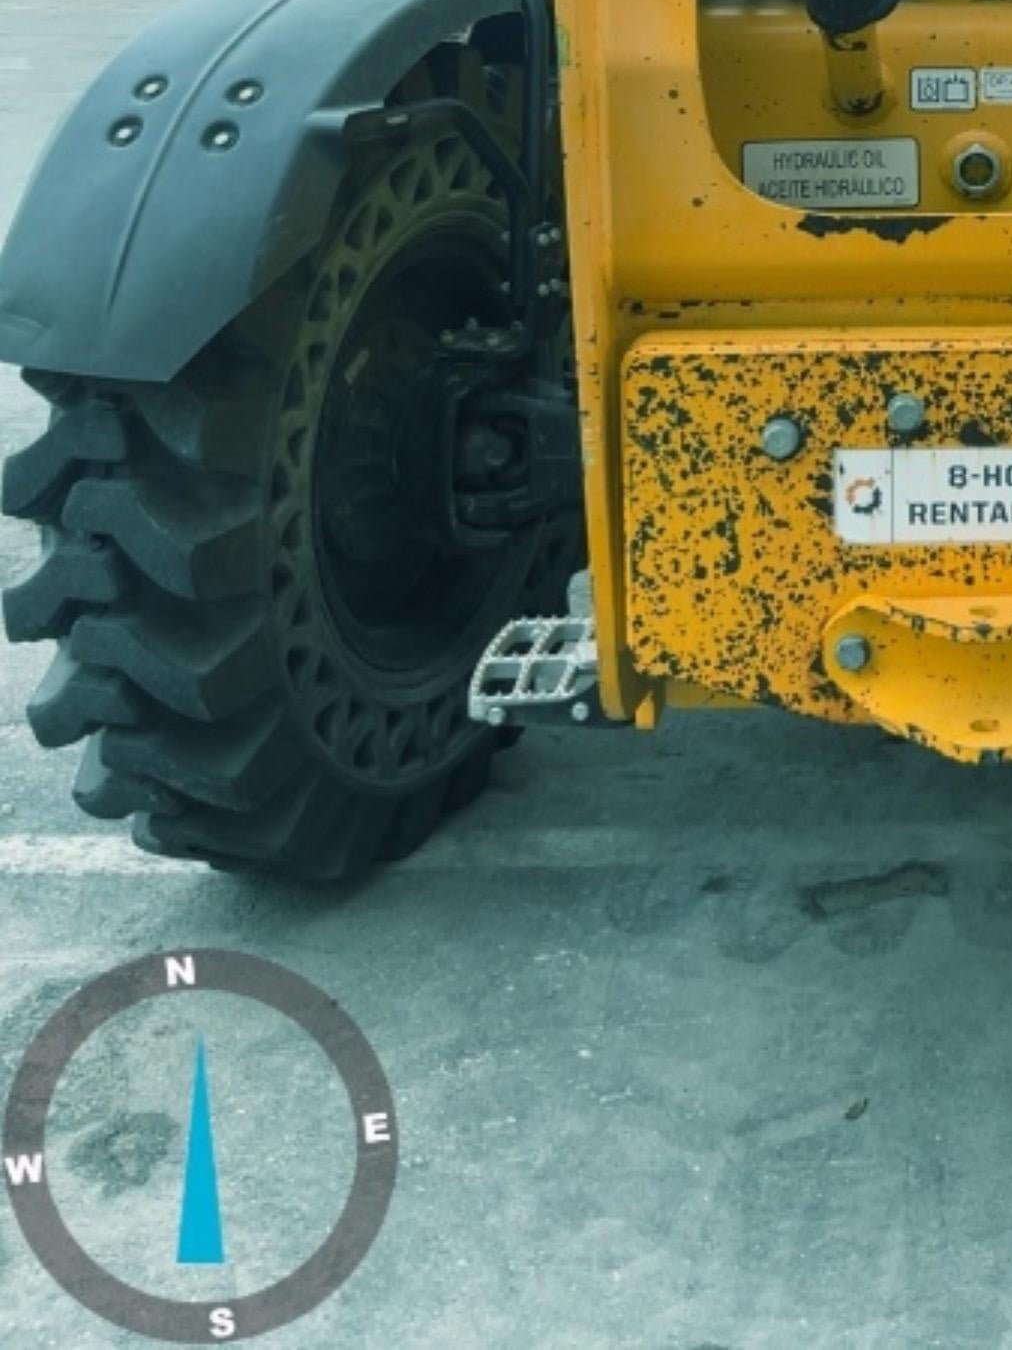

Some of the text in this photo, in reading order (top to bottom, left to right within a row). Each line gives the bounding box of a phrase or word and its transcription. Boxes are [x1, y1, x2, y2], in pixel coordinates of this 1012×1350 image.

[774, 149, 887, 170] HYDRAULIC OIL
[758, 179, 811, 199] ACEITE
